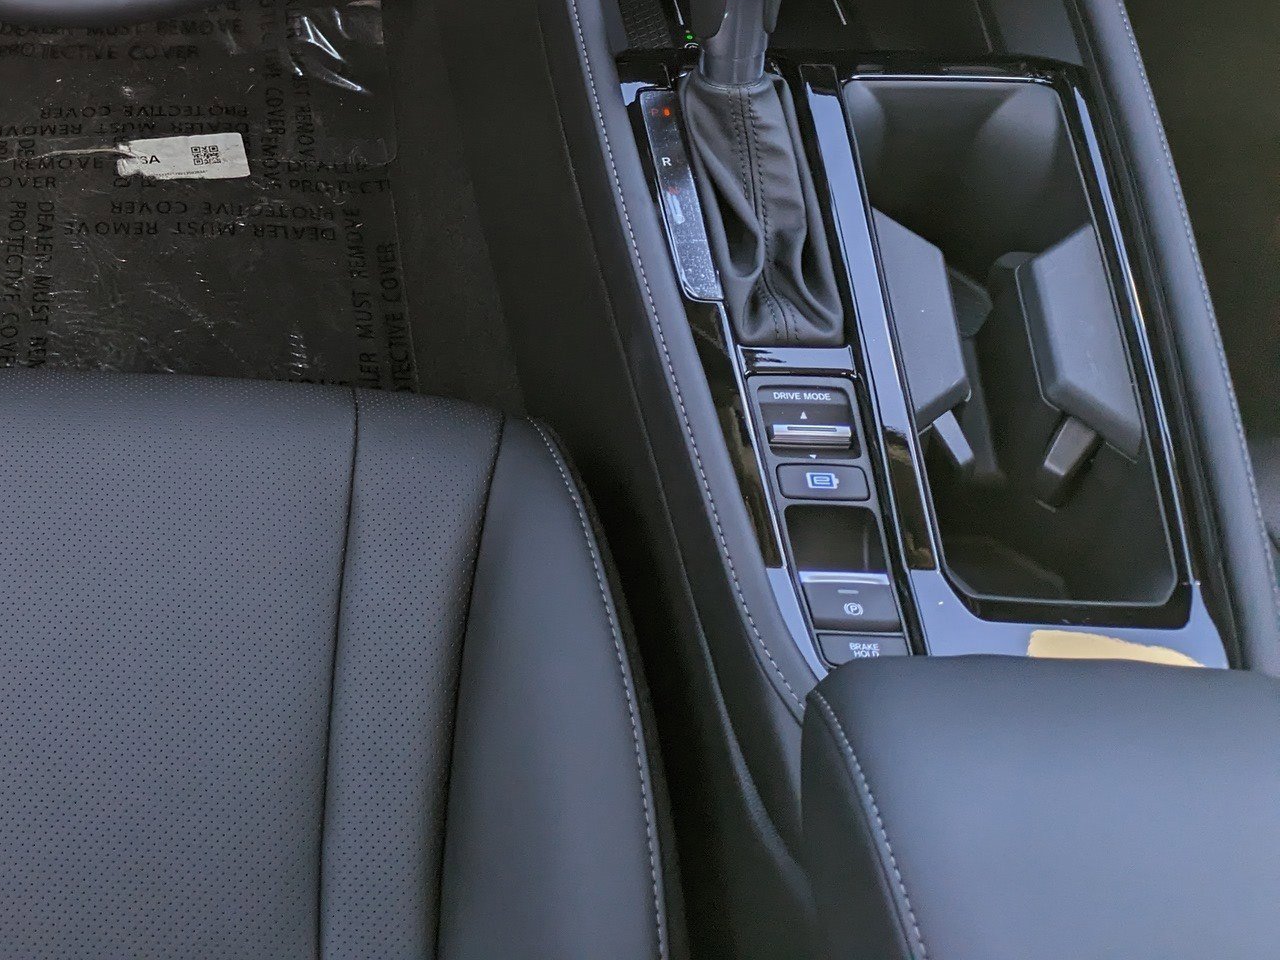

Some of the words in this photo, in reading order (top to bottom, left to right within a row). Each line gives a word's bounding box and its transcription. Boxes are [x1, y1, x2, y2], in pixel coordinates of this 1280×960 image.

[662, 157, 672, 167] R
[773, 391, 801, 400] DRIVE
[803, 392, 831, 401] MODE
[849, 642, 879, 651] BRAKE
